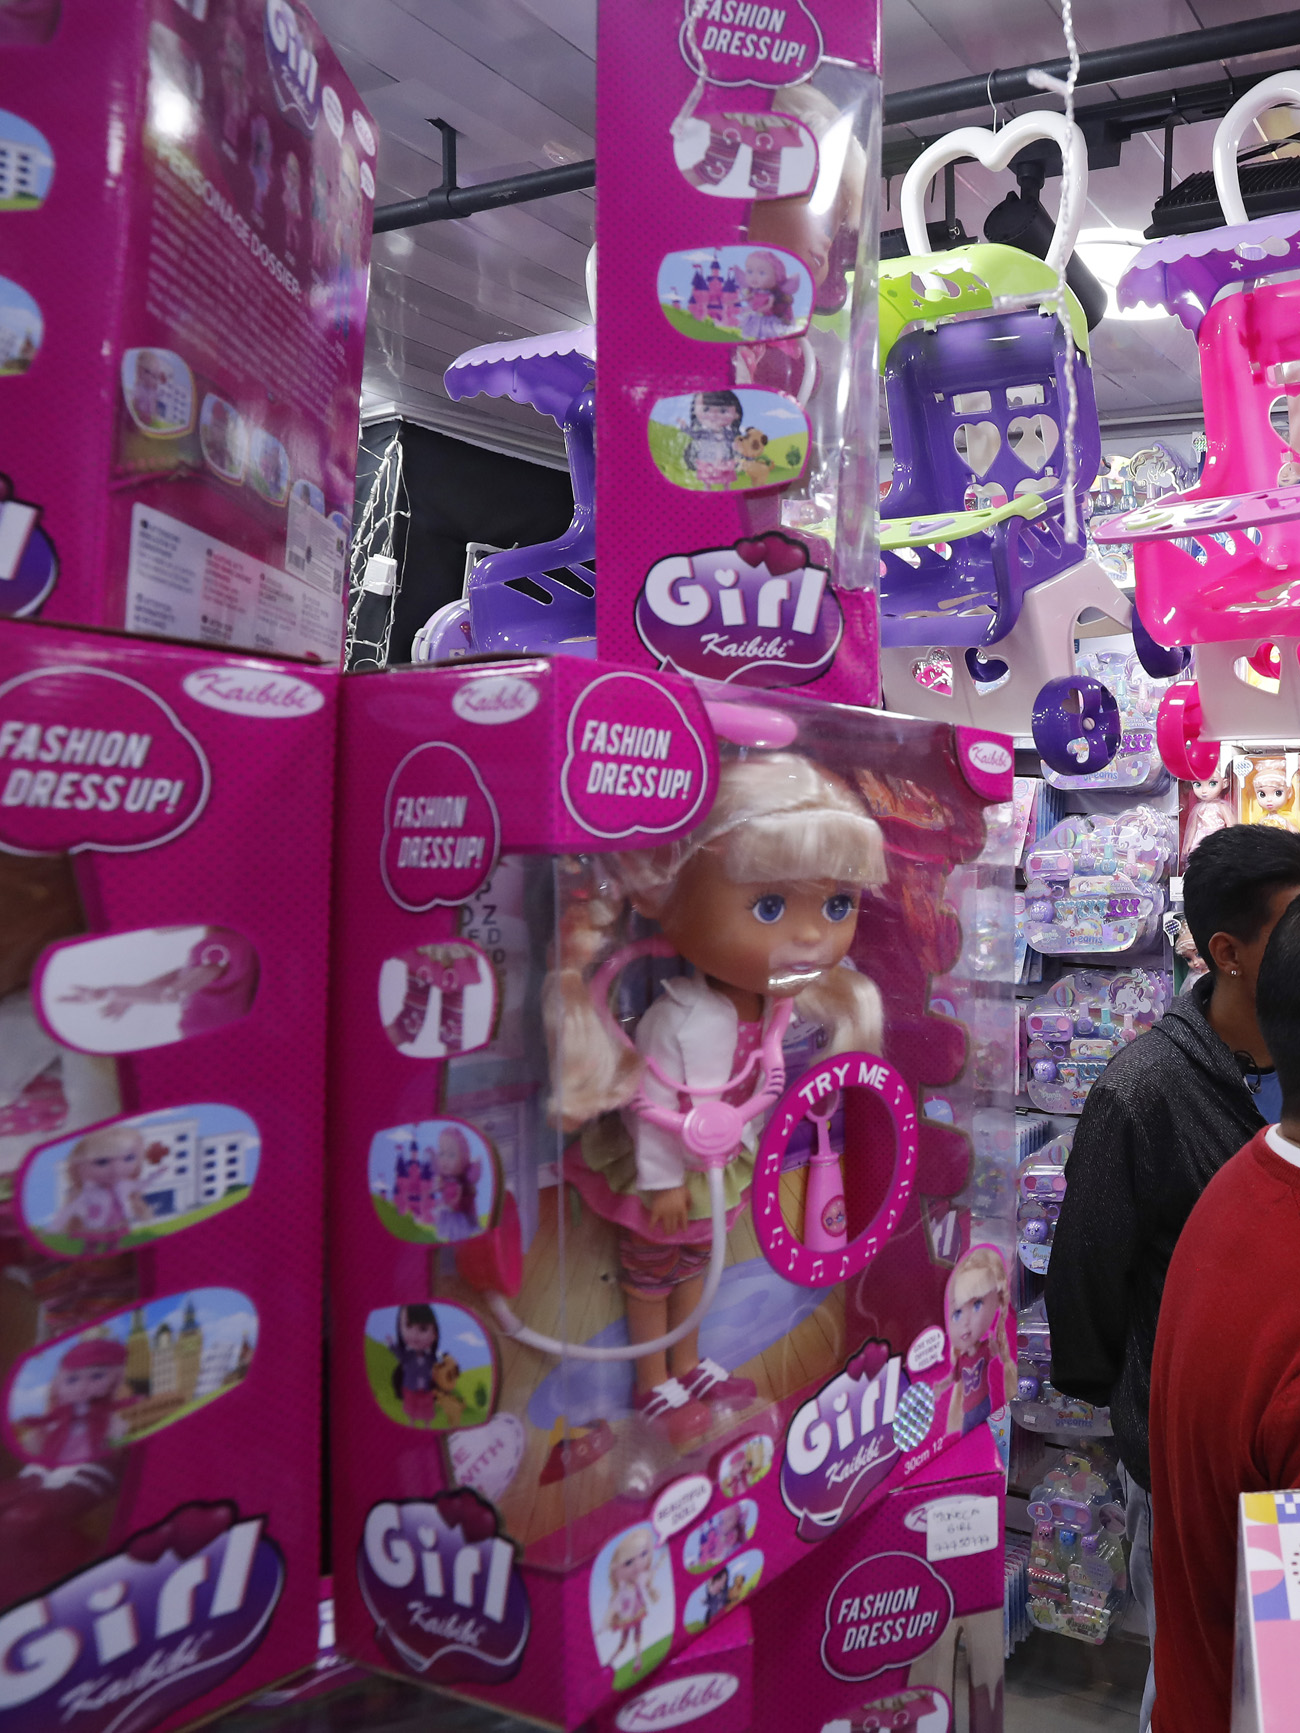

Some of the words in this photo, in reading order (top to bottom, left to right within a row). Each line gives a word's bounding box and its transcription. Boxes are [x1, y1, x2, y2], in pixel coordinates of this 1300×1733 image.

[695, 0, 787, 33] FASHION
[702, 26, 767, 60] DRESS
[771, 41, 808, 67] UP!
[645, 555, 828, 635] Girl
[700, 632, 789, 659] Kaibibi
[197, 671, 312, 708] Kaibibi
[0, 721, 151, 770] FASHION
[581, 719, 671, 760] FASHION
[3, 769, 125, 811] DRESS
[127, 777, 184, 814] UP!
[587, 762, 658, 798] DRESS
[657, 770, 693, 801] UP!
[394, 796, 468, 829] FASHION
[398, 836, 452, 868] DRESS
[451, 837, 486, 869] UP!
[1066, 935, 1103, 945] Dreams
[798, 1062, 853, 1106] TRY
[858, 1060, 891, 1088] ME
[787, 1356, 902, 1475] Girl
[825, 1436, 884, 1490] Kaibibi
[364, 1502, 514, 1622] Girl
[0, 1517, 264, 1699] Girl
[837, 1586, 919, 1624] FASHION
[842, 1616, 905, 1653] DRESS
[904, 1609, 938, 1643] UP!
[627, 1676, 730, 1730] Kaibibi
